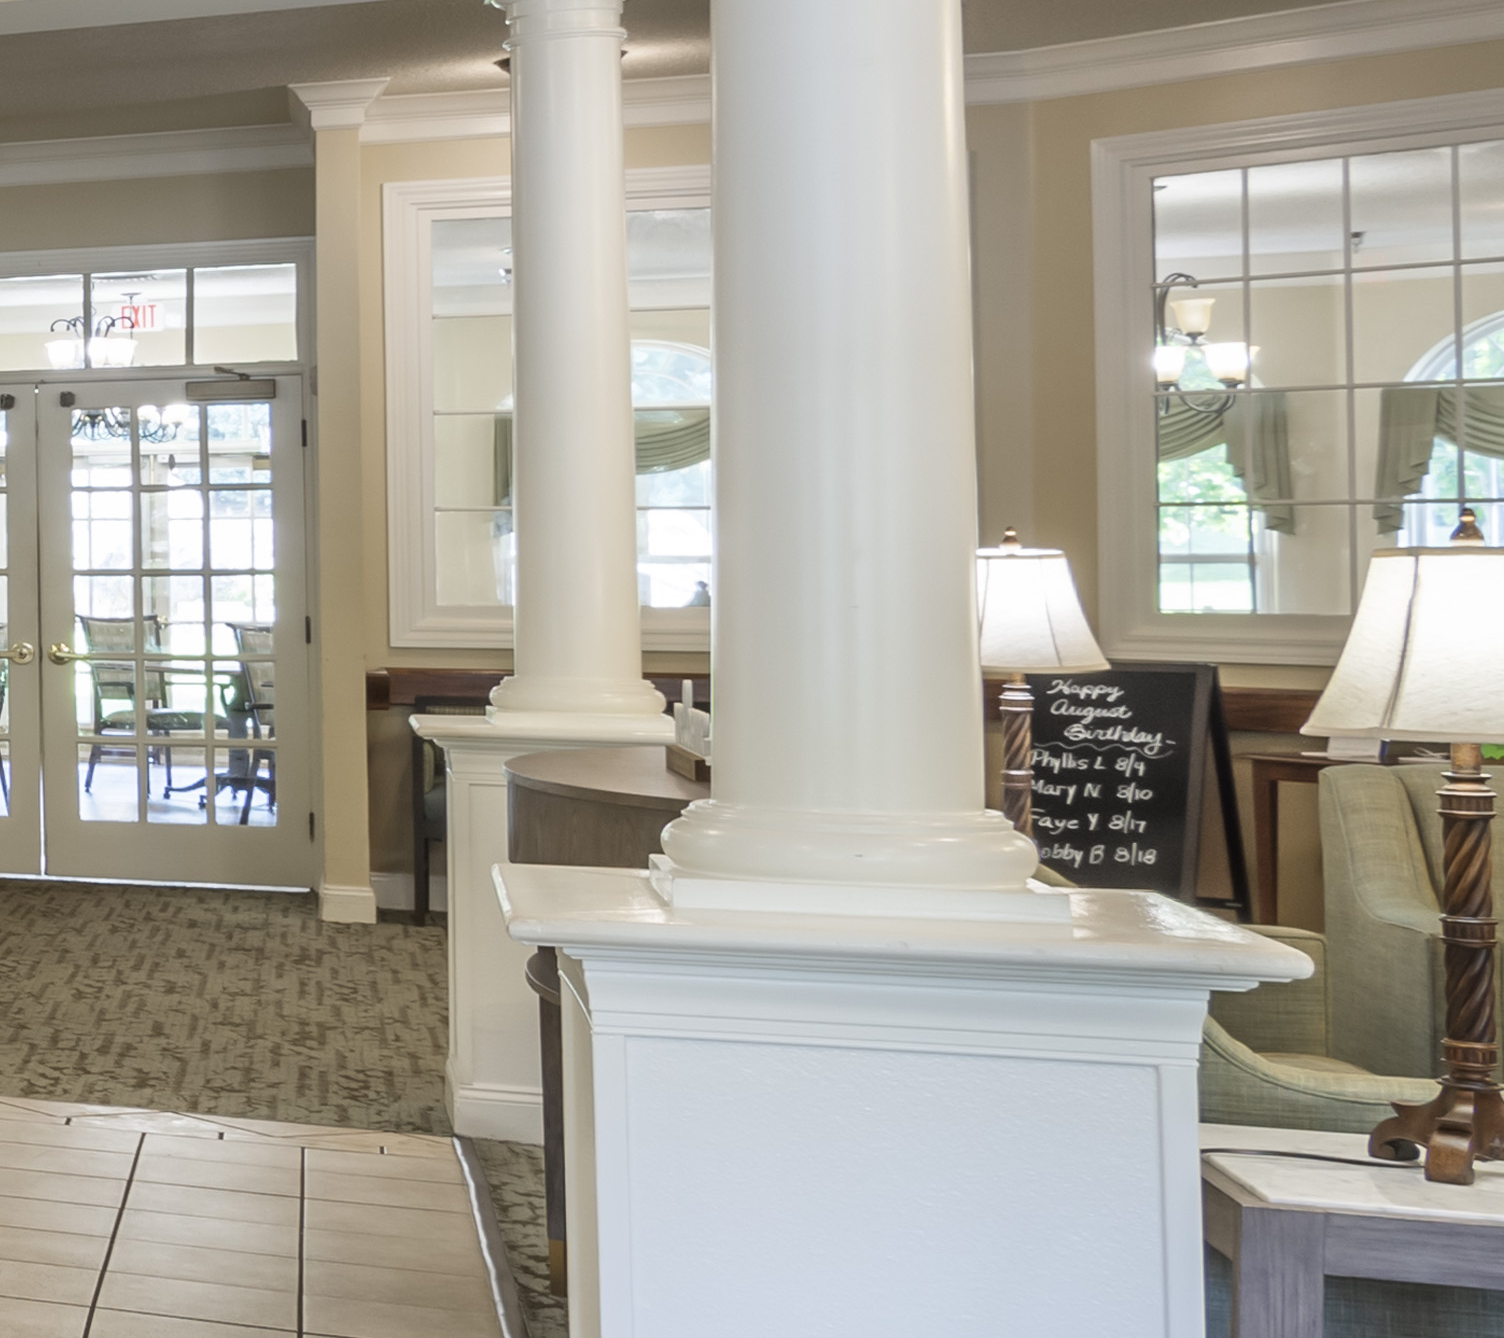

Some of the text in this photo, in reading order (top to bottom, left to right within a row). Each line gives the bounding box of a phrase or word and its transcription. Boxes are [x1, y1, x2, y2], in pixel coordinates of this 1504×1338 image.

[121, 304, 157, 330] EXIT
[1046, 679, 1124, 702] Happy
[1050, 698, 1133, 724] August
[1093, 756, 1107, 770] L
[1083, 783, 1102, 799] N
[1115, 782, 1153, 804] 8/10
[1087, 812, 1099, 831] Y
[1108, 810, 1147, 834] 8/17
[1039, 842, 1157, 869] obby B 8/18
